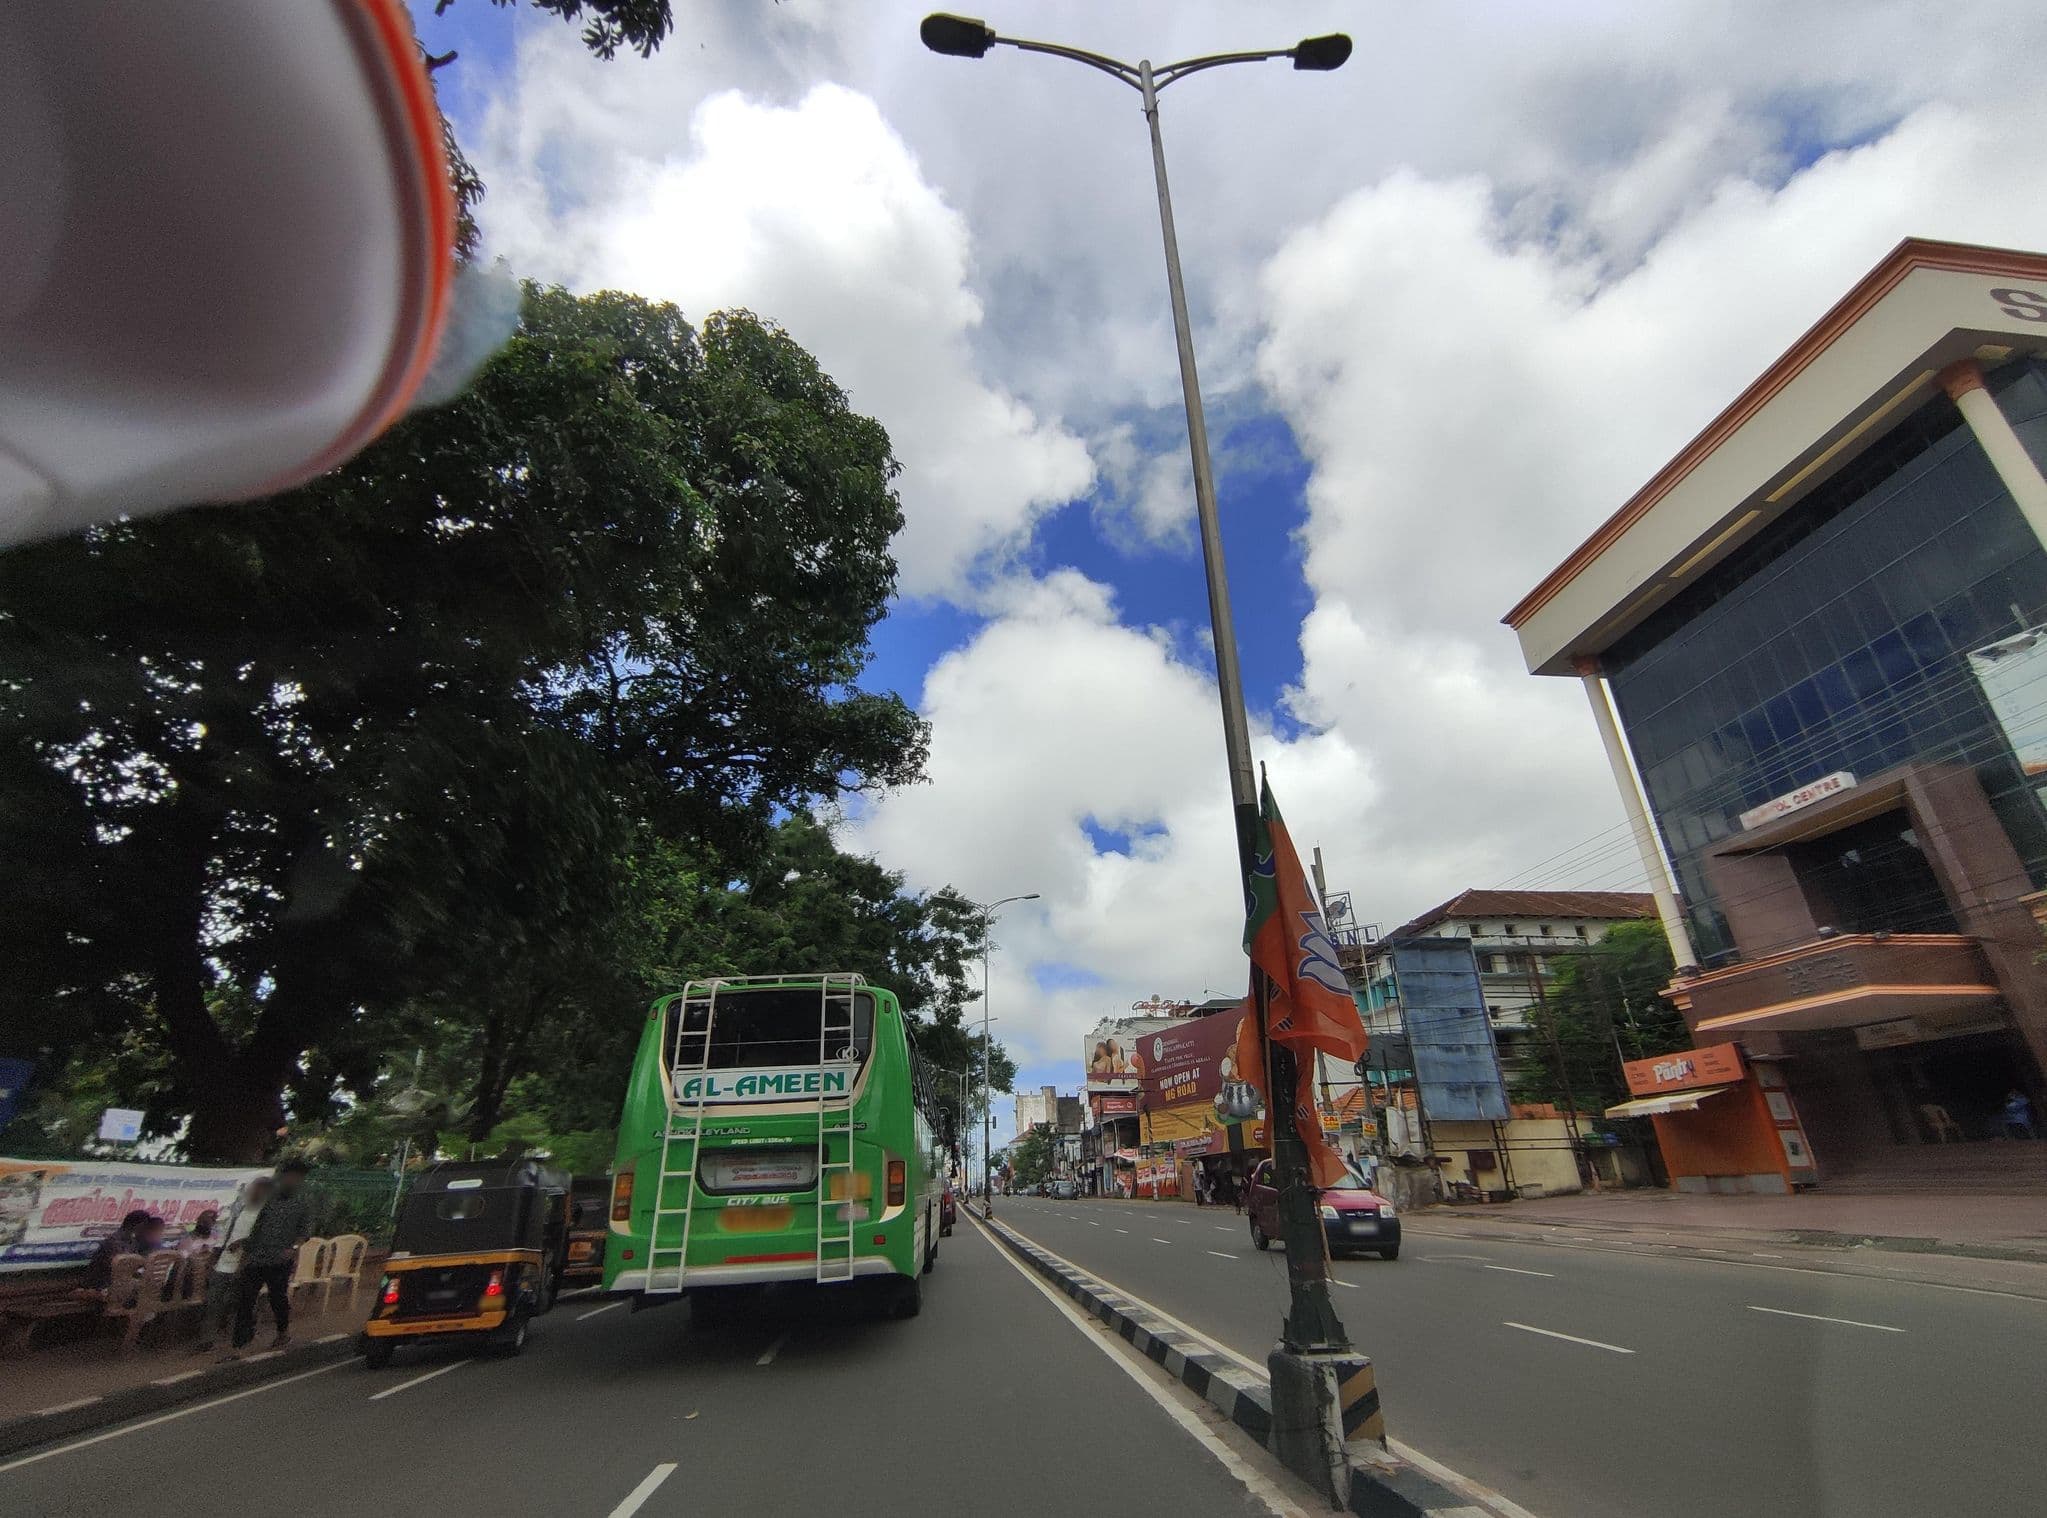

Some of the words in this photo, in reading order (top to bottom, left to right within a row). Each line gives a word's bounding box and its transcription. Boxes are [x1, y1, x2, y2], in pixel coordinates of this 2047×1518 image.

[1792, 777, 1841, 805] CENTRE
[683, 1071, 845, 1099] AL-AMEEN
[1160, 1076, 1173, 1090] NOW
[1173, 1070, 1191, 1085] OPEN
[1192, 1067, 1200, 1080] AT
[1176, 1081, 1197, 1098] ROAD
[727, 1196, 759, 1206] CITY
